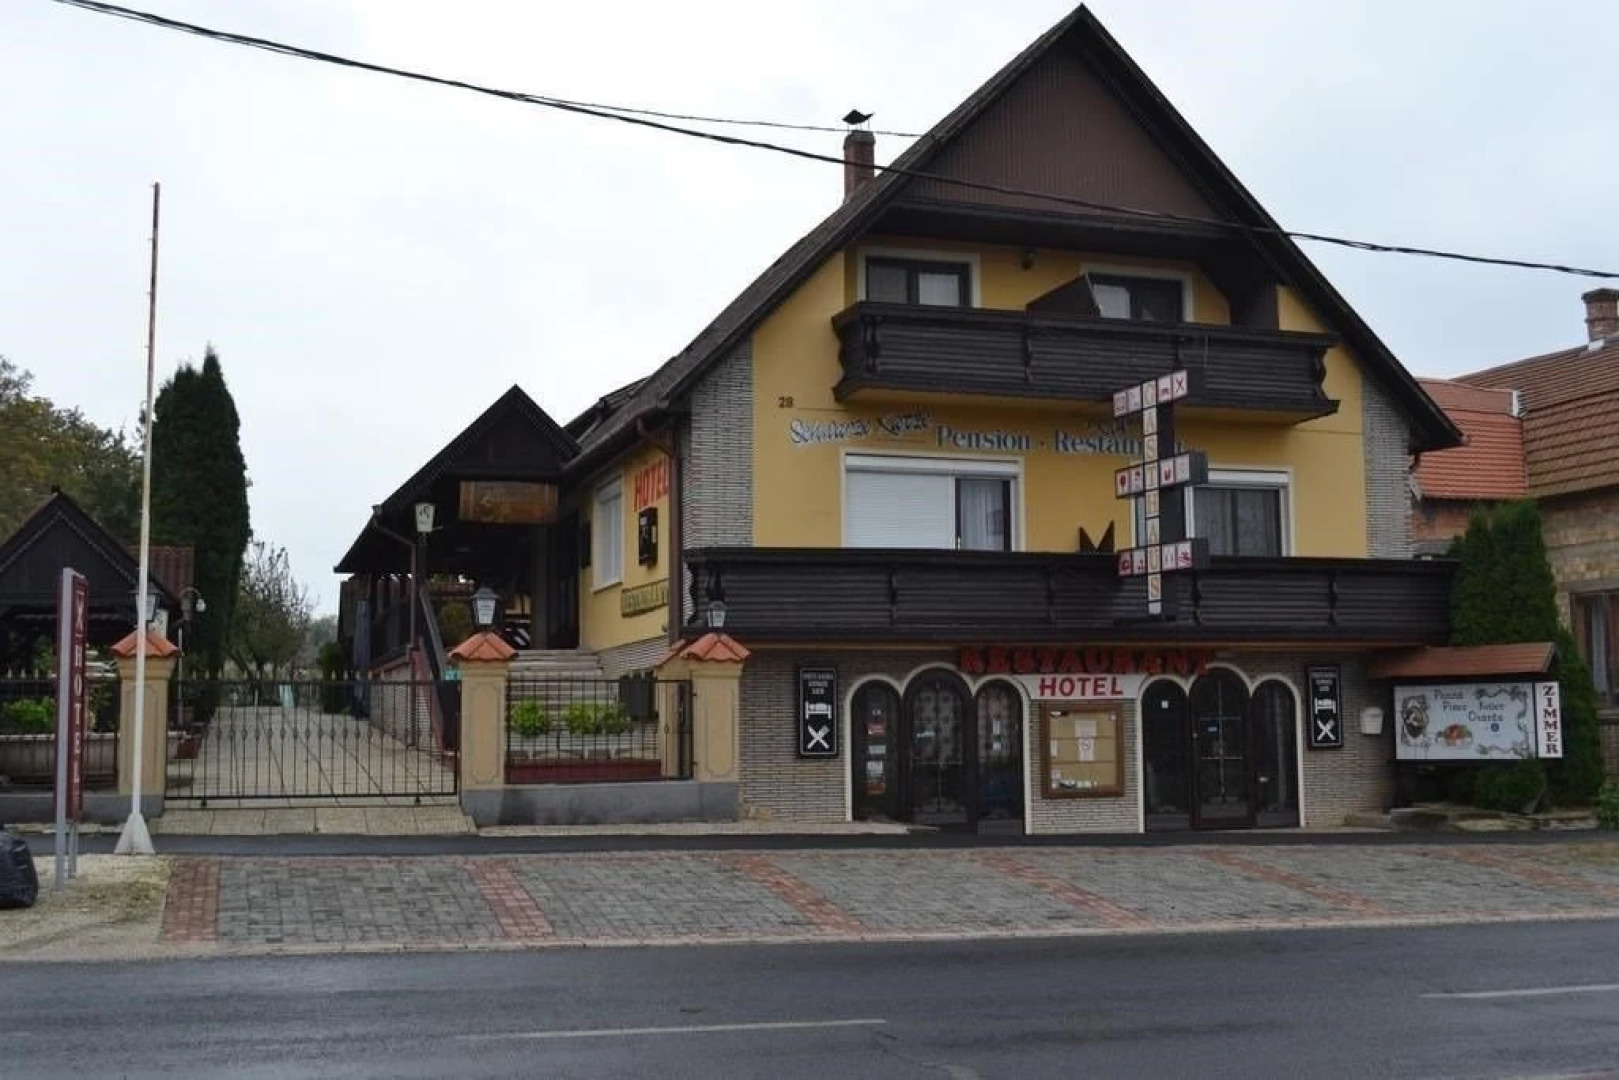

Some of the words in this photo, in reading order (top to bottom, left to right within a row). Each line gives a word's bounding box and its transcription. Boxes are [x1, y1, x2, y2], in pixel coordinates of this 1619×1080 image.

[778, 396, 793, 408] 28
[937, 424, 1030, 450] Pension
[633, 458, 670, 513] HOTEL
[960, 645, 1210, 678] RESTAURANT
[1038, 676, 1124, 697] HOTEL
[1542, 685, 1559, 755] ZIMMER
